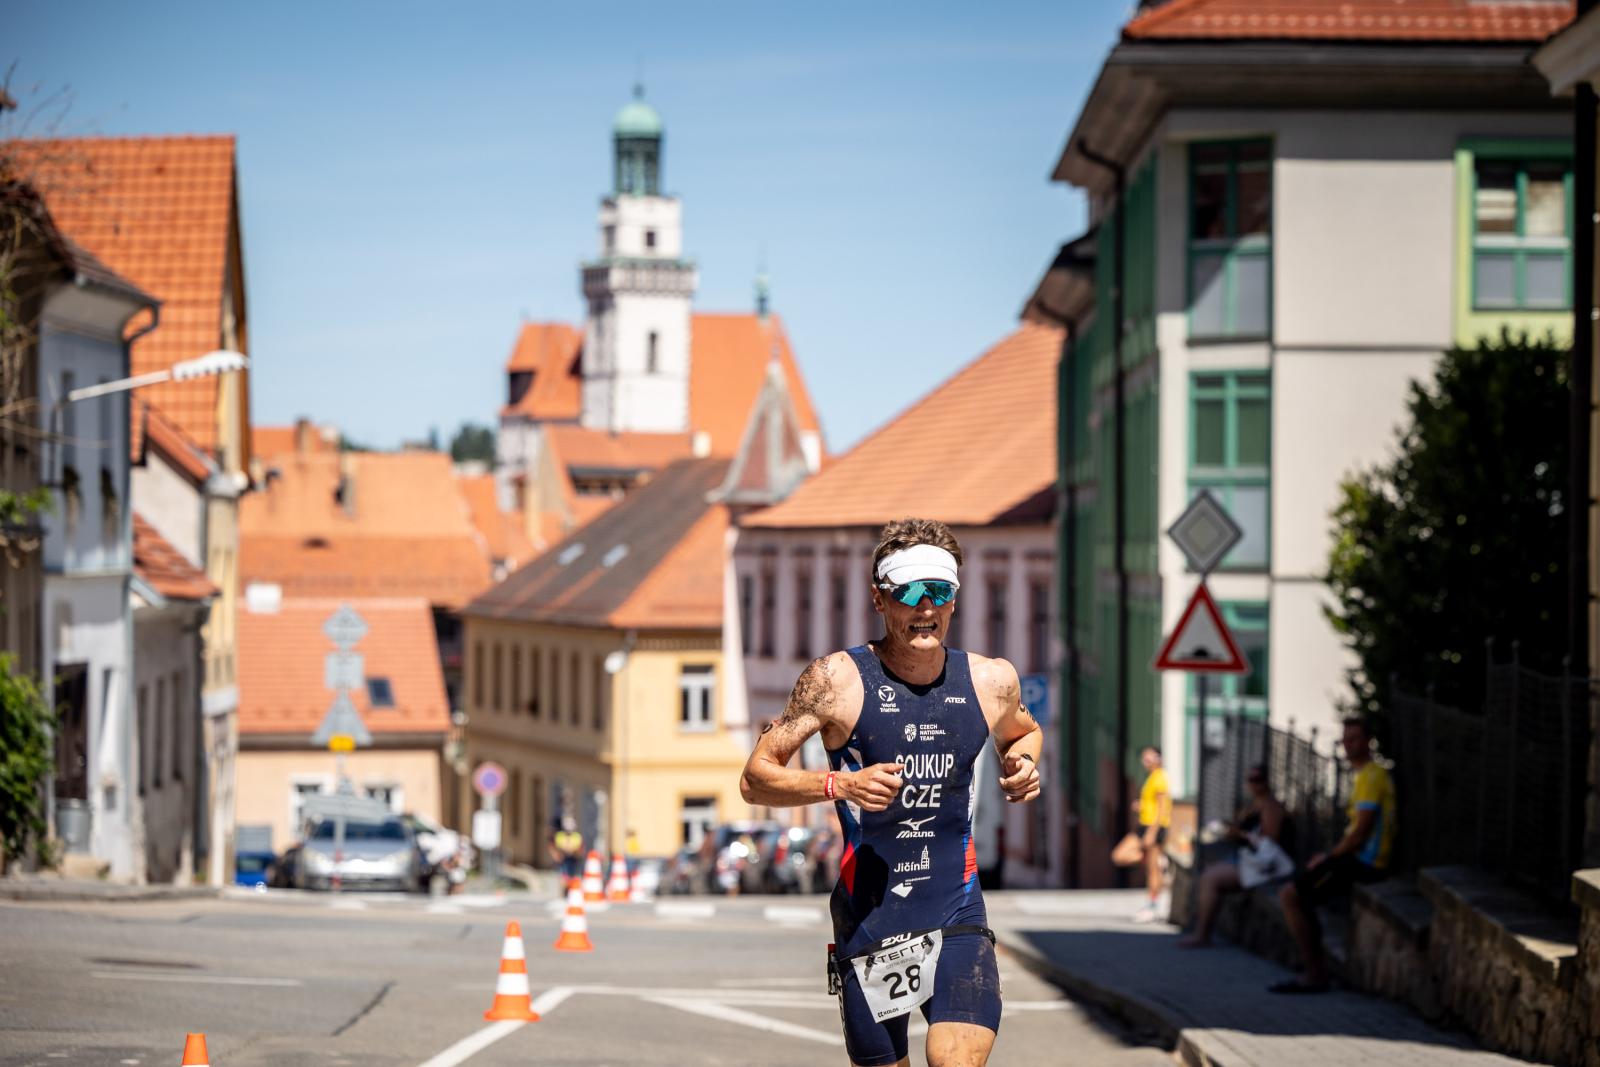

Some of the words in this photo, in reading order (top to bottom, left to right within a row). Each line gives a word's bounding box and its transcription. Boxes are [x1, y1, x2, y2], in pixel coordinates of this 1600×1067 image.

[901, 784, 942, 809] CZE
[893, 862, 921, 873] Jičín
[881, 932, 912, 948] 2XU
[882, 965, 921, 1000] 28
